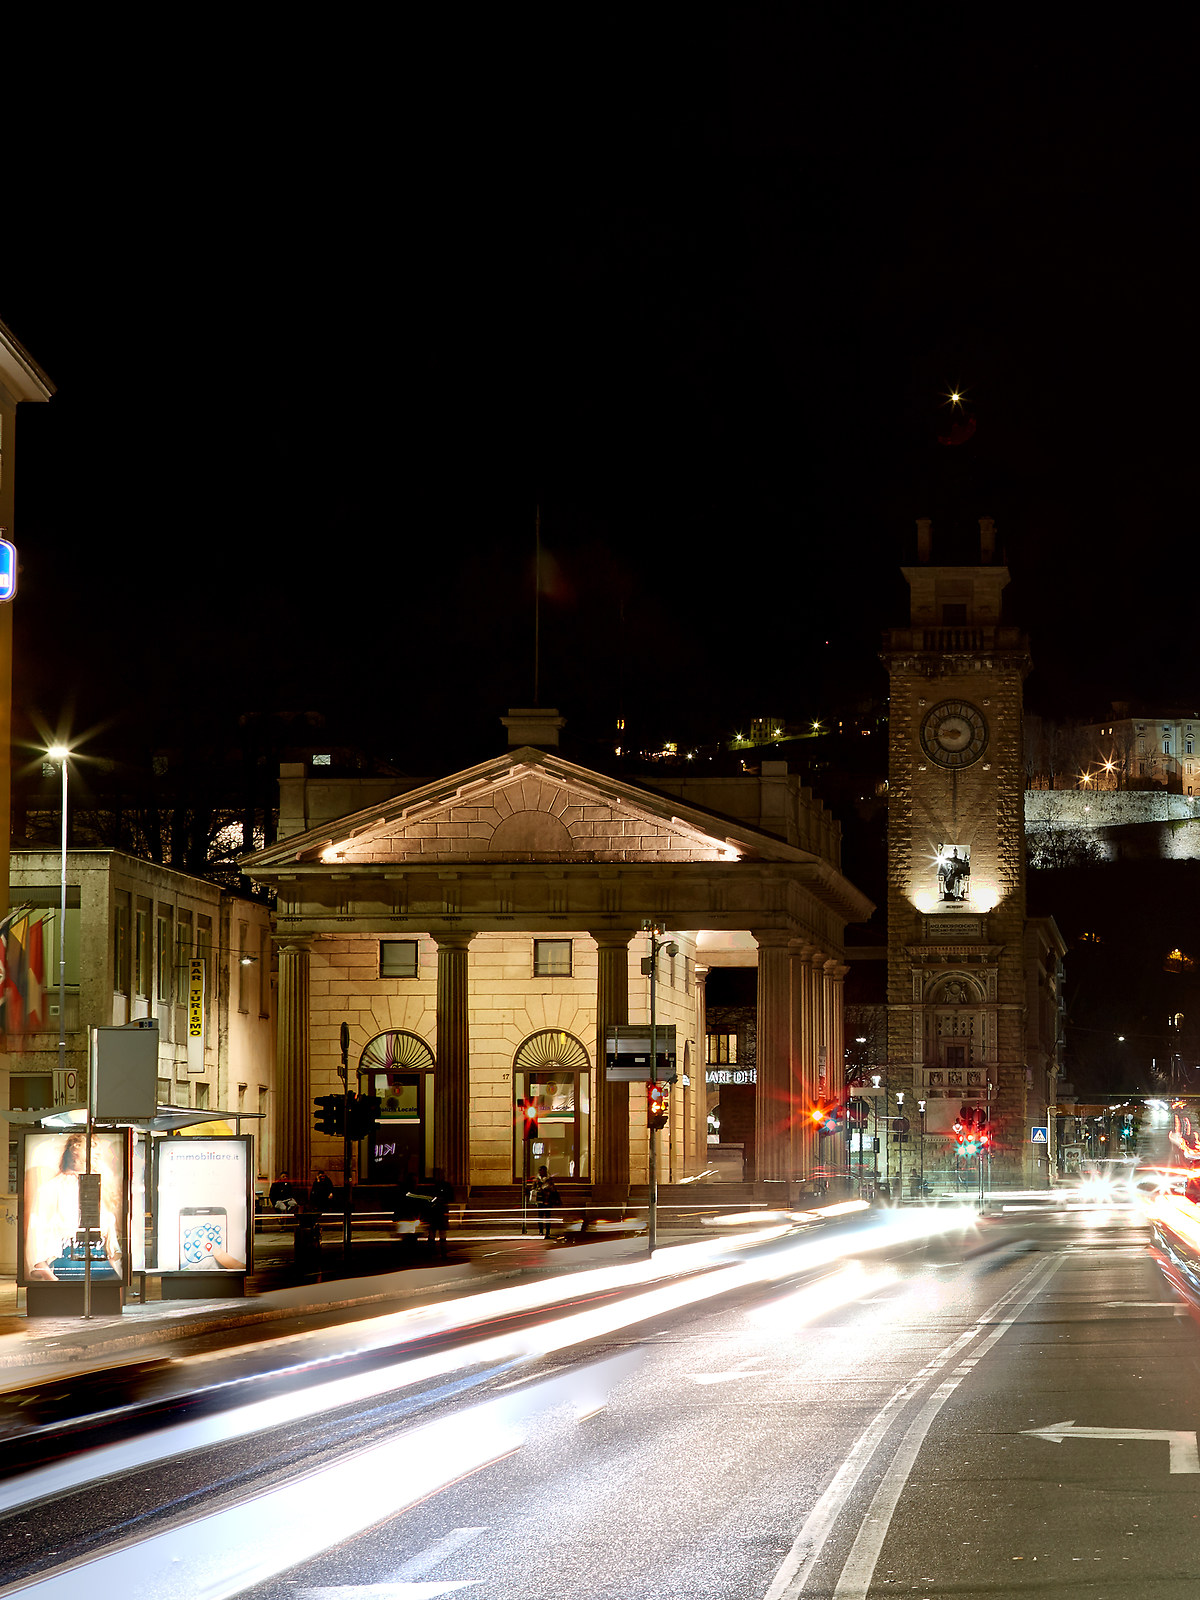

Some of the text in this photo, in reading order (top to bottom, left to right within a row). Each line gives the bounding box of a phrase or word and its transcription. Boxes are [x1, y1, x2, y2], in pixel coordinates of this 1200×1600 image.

[190, 962, 202, 1036] BAR TURISMO
[170, 1152, 239, 1160] immobiliare.it
